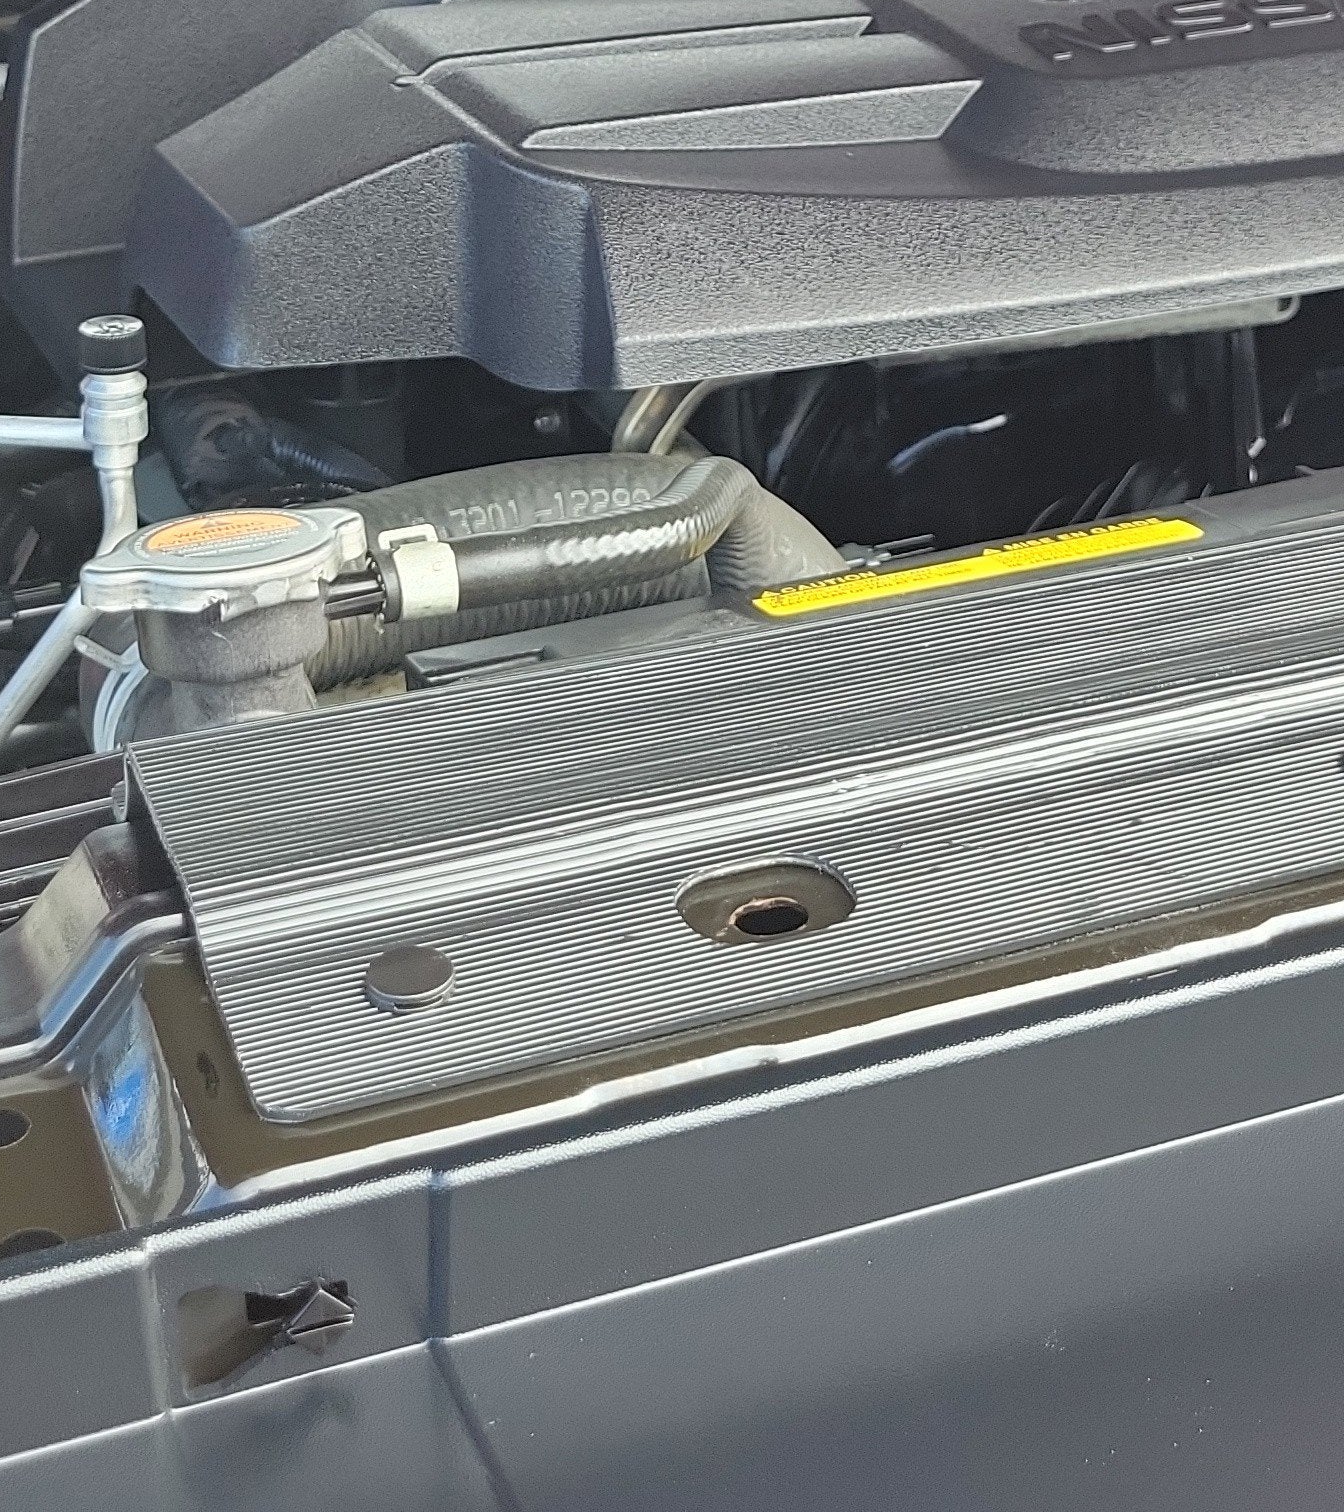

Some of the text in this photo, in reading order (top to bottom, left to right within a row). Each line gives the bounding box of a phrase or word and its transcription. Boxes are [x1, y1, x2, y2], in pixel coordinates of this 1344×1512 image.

[1003, 517, 1163, 551] MISE EN GARDE
[781, 570, 878, 594] CAUTION
